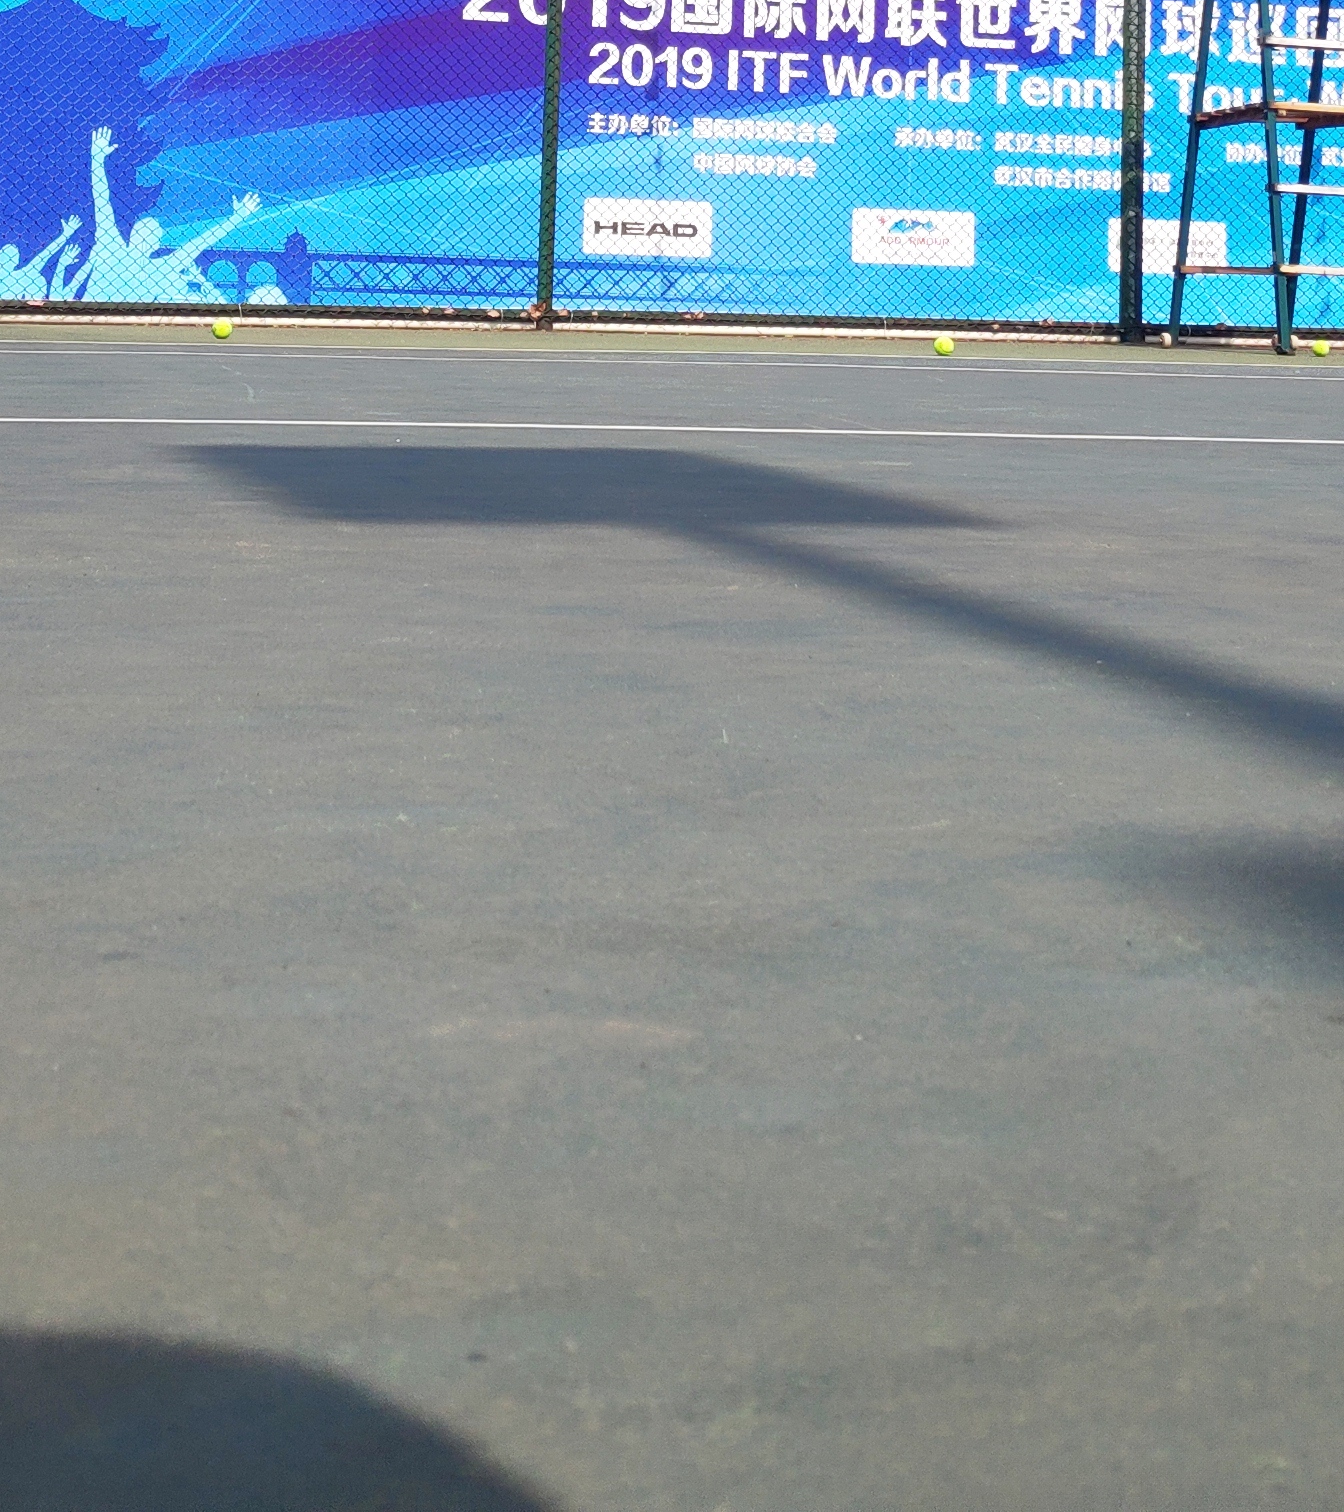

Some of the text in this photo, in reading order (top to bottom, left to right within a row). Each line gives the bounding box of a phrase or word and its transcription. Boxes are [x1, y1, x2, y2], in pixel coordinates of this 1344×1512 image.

[588, 41, 713, 90] 2019
[727, 50, 809, 94] ITF
[824, 54, 969, 104] World
[594, 220, 698, 238] HEAD
